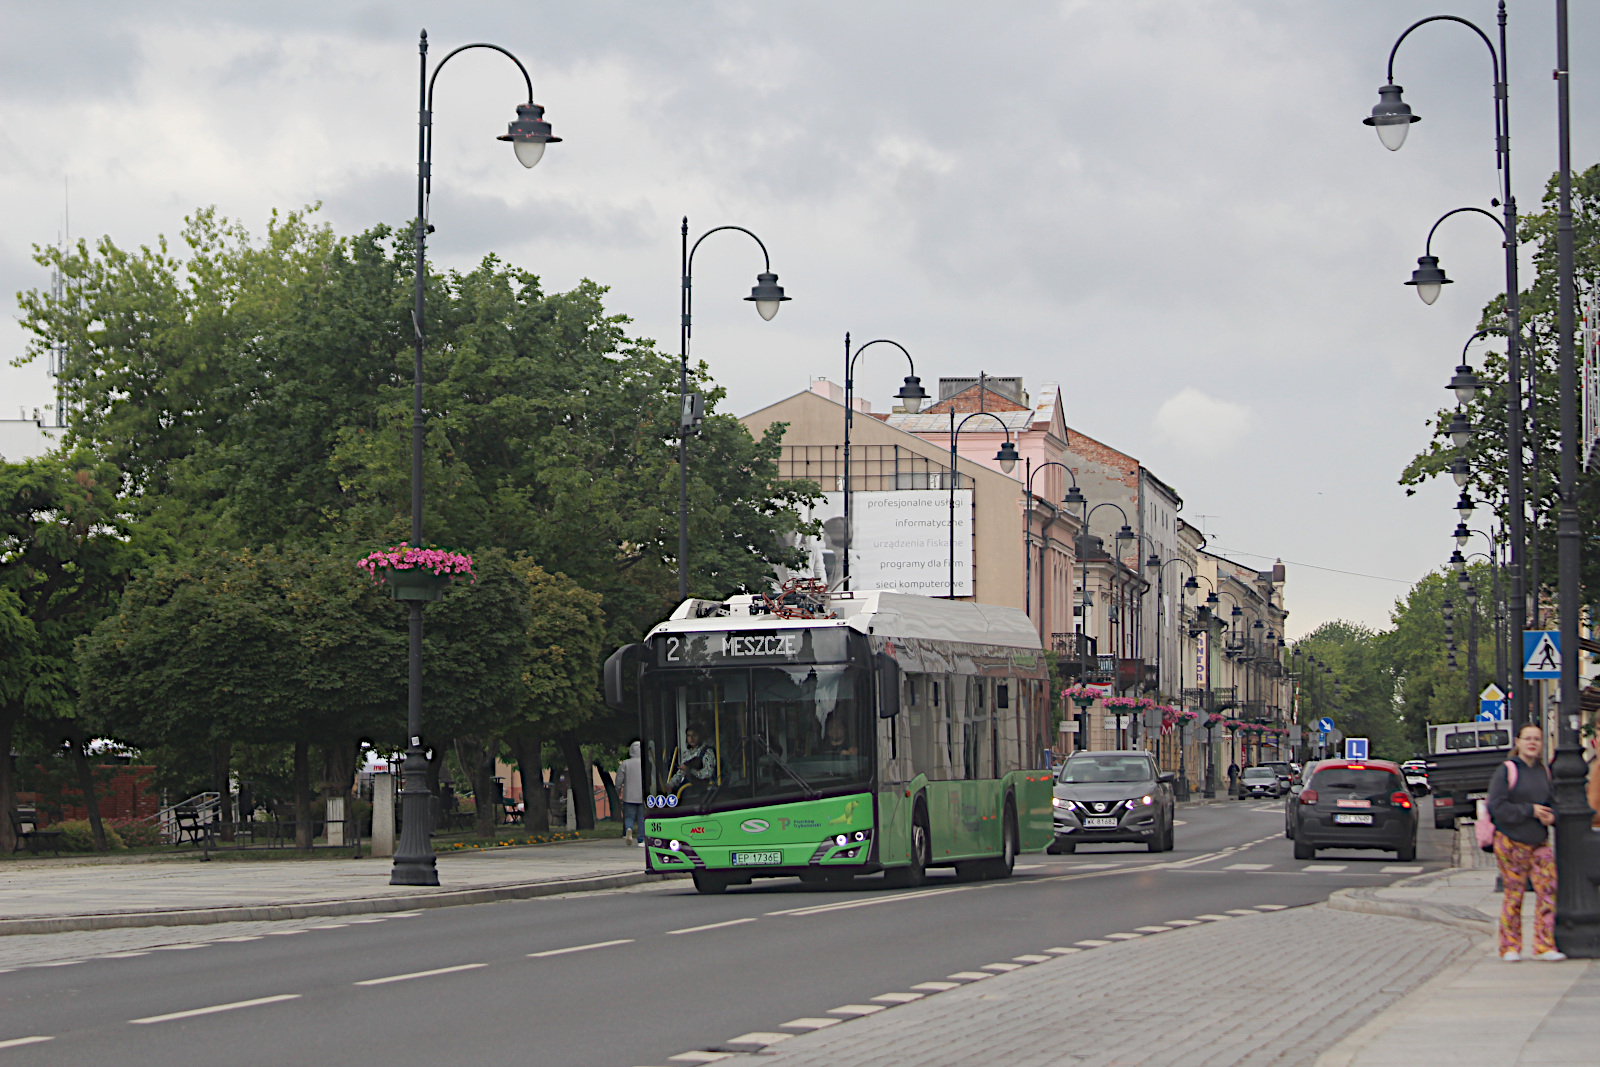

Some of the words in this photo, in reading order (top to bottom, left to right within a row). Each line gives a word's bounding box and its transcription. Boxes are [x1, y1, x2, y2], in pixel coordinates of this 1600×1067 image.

[867, 499, 933, 508] profesjonalne
[934, 498, 963, 508] usłgi
[873, 538, 925, 549] urządzenia
[926, 539, 964, 547] fiskane
[880, 560, 926, 569] programy
[927, 559, 941, 567] dla
[875, 580, 898, 588] sieci
[666, 637, 680, 661] 2
[721, 635, 797, 656] MESZCZE
[1352, 742, 1363, 756] L
[651, 822, 662, 832] 36
[737, 854, 749, 862] EP
[753, 852, 779, 861] 1736E
